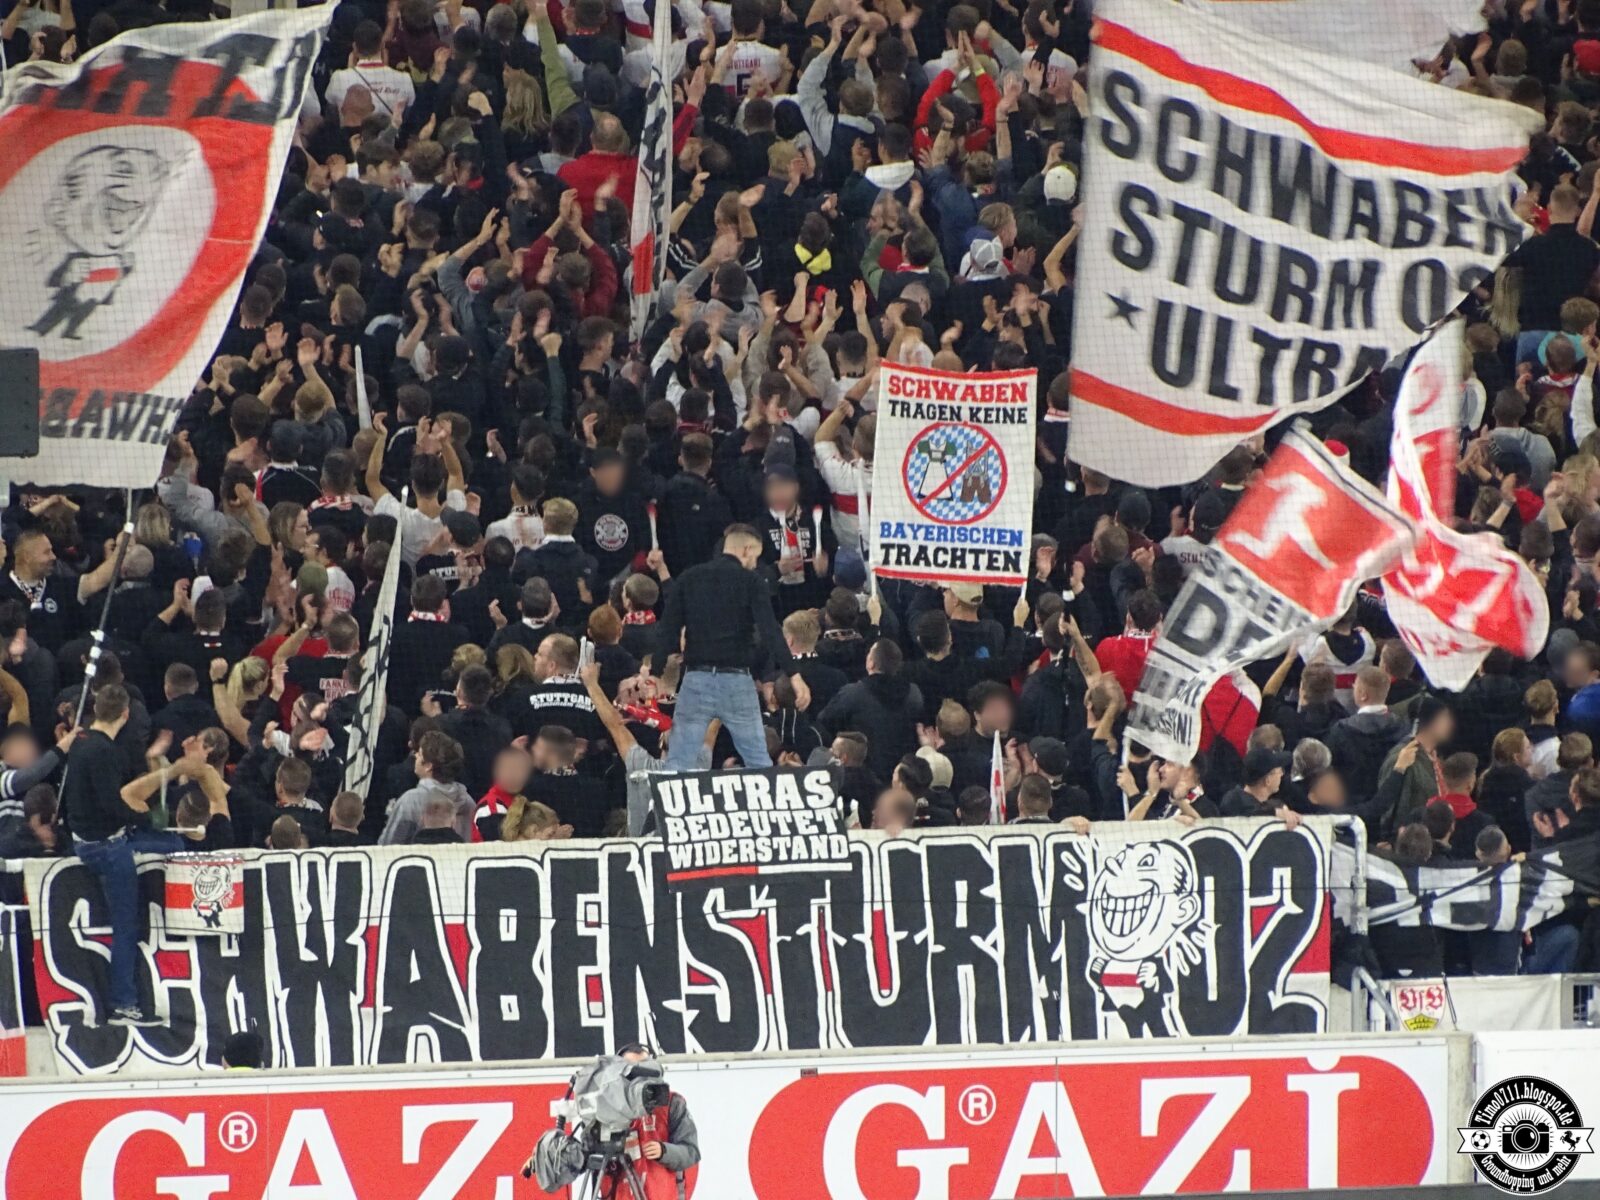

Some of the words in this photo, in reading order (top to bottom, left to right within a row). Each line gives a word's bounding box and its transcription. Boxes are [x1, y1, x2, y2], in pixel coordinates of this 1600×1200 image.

[1111, 182, 1382, 331] STURM
[888, 375, 1028, 404] SCHWABEN
[889, 400, 962, 422] TRAGEN
[969, 406, 1028, 424] KEINE
[880, 521, 1024, 547] BAYERISCHEN
[880, 543, 1022, 573] TRACHTEN
[529, 692, 595, 707] STUTTGAR
[656, 770, 836, 818] ULTRAS
[665, 807, 840, 845] BEDEUTET
[668, 834, 850, 871] WIDERSTAND
[1172, 821, 1328, 1040] 02
[1399, 983, 1444, 1013] VfB
